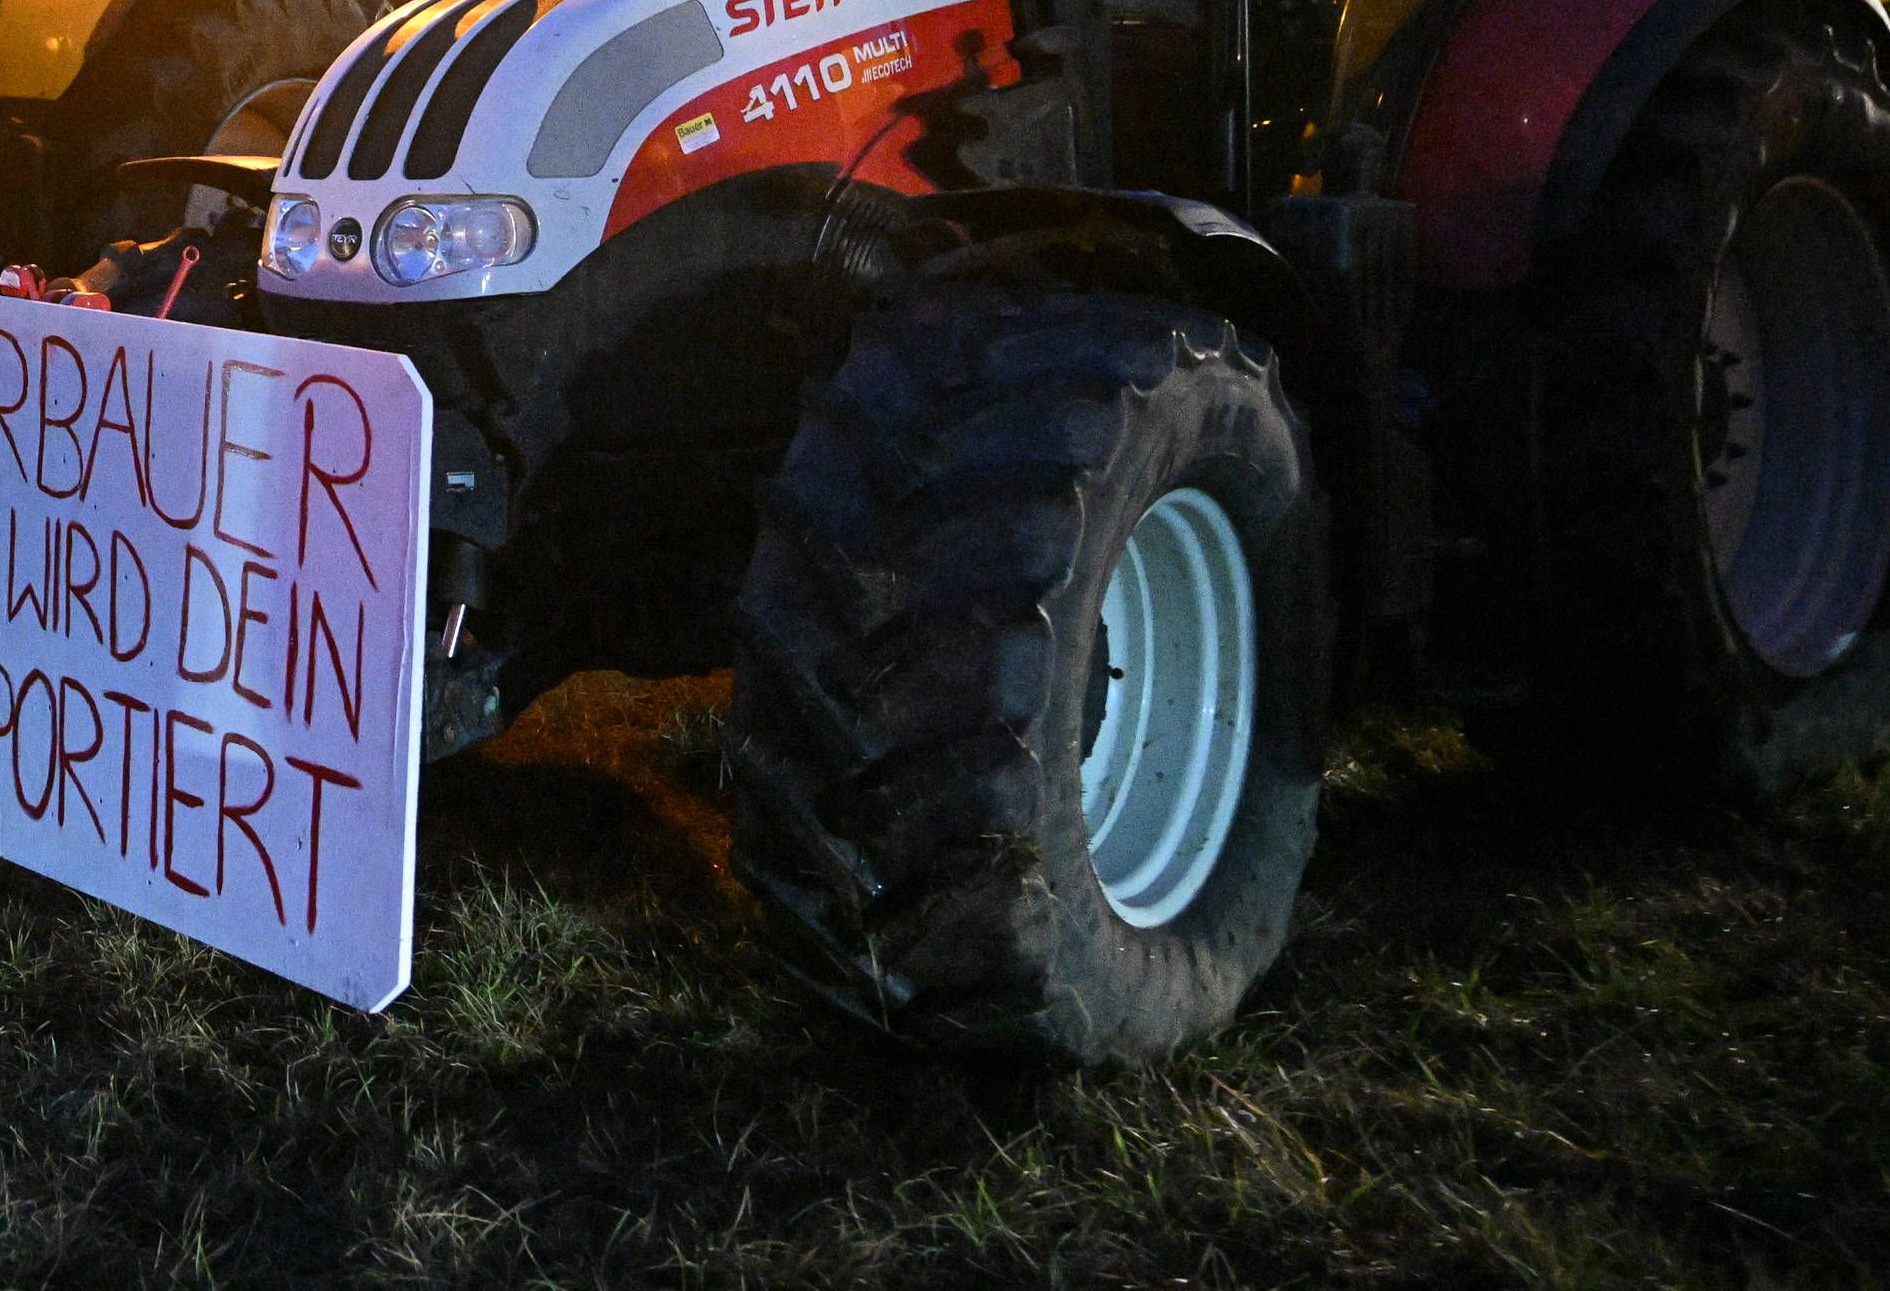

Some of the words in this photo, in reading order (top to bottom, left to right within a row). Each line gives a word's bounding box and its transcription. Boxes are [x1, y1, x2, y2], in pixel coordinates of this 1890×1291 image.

[852, 30, 908, 64] MULTI
[740, 53, 853, 123] 4110
[330, 234, 358, 244] TEYR
[36, 335, 379, 591] BAUER
[7, 507, 151, 663] WIRD
[177, 546, 365, 743] DEIN
